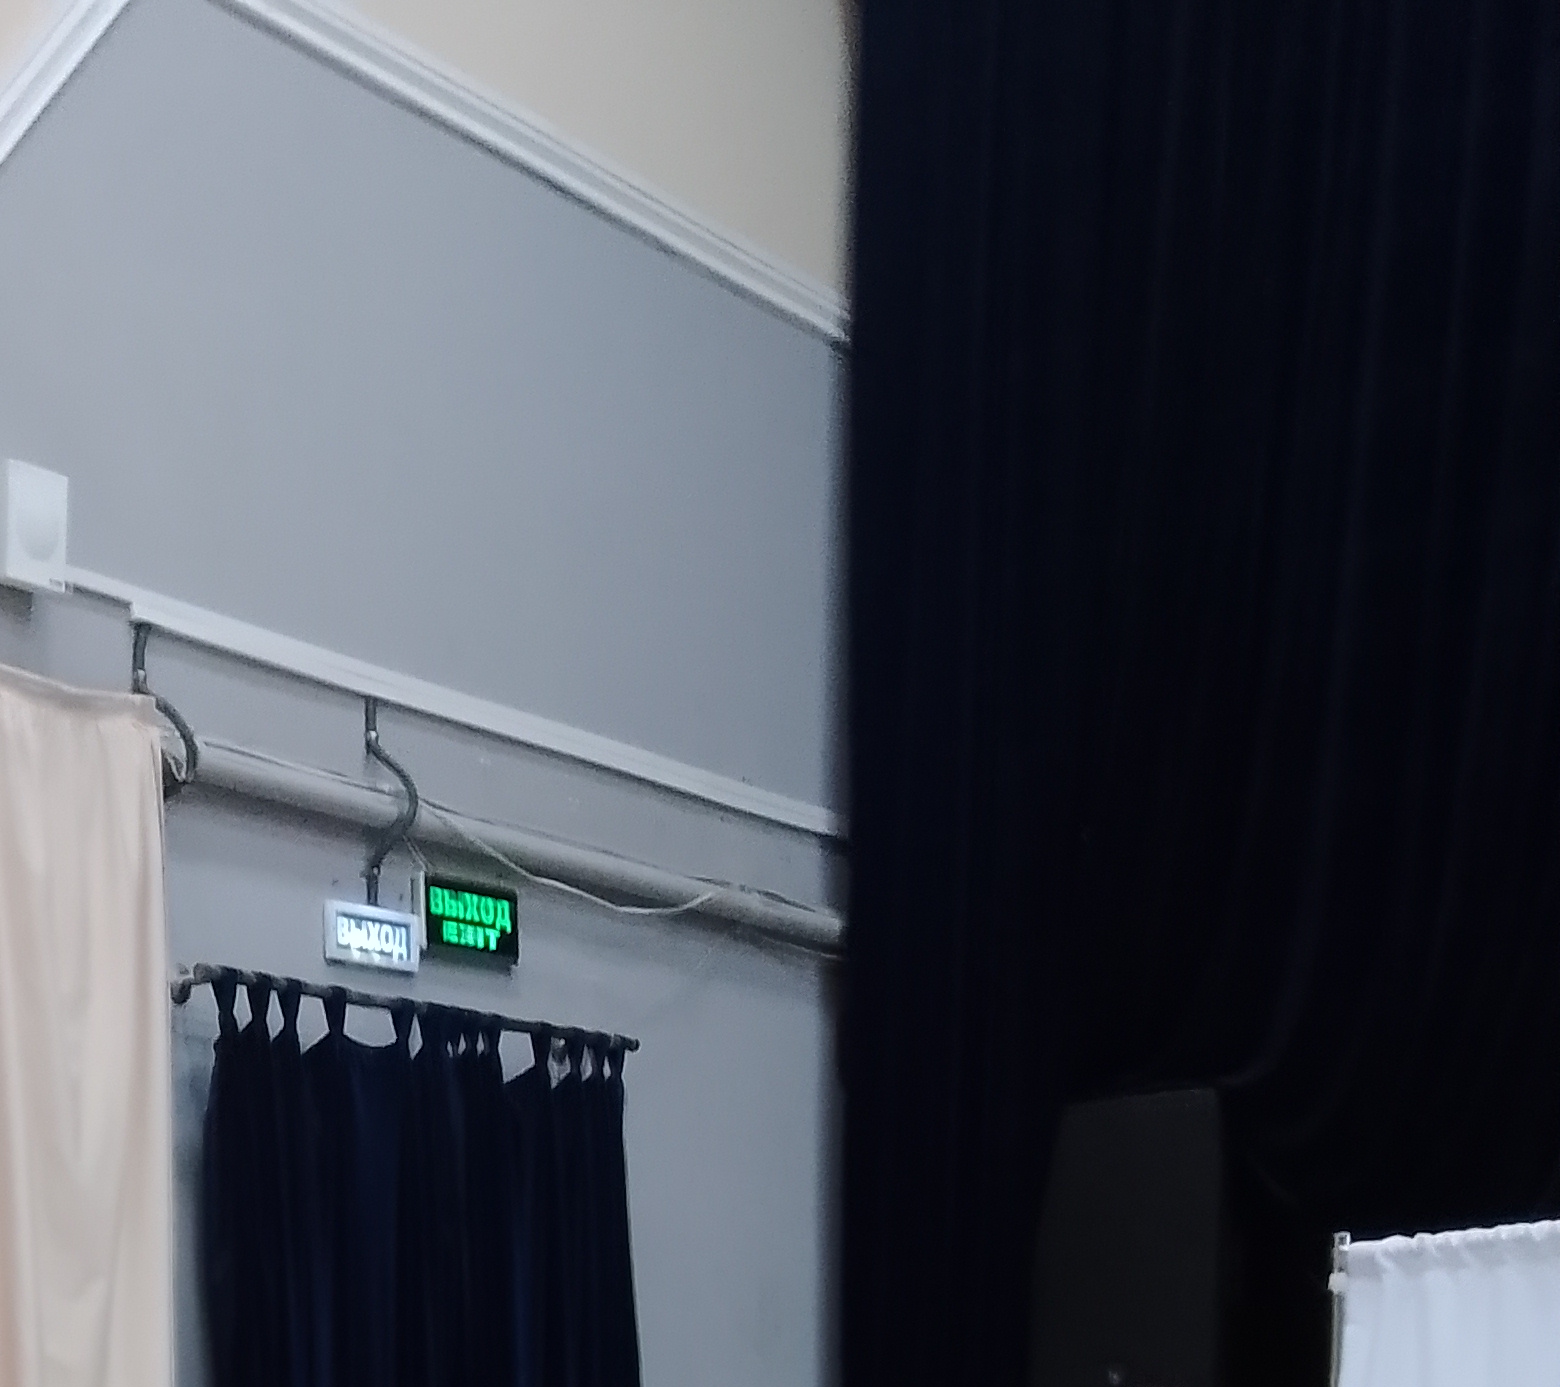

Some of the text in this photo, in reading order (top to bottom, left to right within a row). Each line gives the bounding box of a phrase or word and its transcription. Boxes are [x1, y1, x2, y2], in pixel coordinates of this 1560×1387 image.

[430, 885, 512, 934] ВЫХОД
[337, 915, 408, 962] ВЫХОД
[442, 919, 501, 951] EXIT
